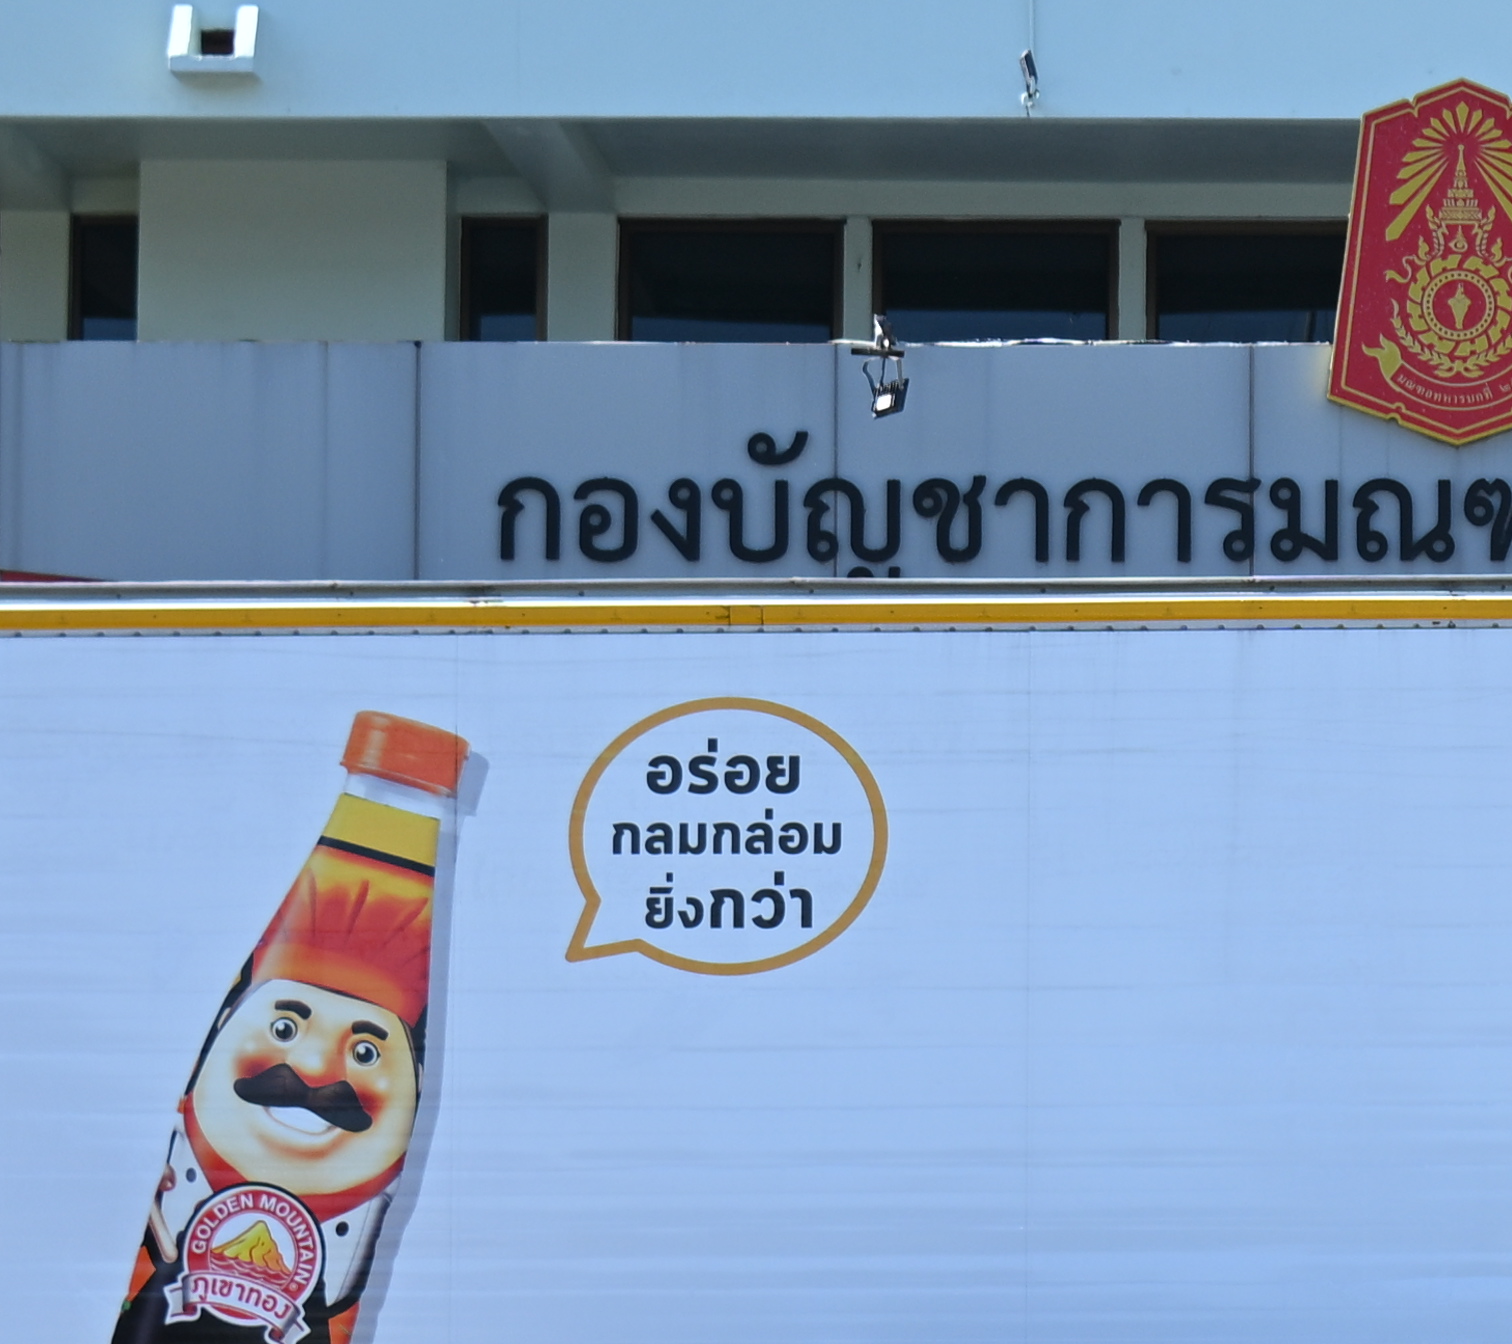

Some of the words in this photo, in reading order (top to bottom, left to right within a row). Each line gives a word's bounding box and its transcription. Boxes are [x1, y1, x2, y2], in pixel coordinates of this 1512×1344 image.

[646, 737, 801, 795] อร่อย
[612, 808, 842, 855] กลมกล่อม
[644, 871, 813, 930] ยิ่งกว่า
[191, 1193, 254, 1254] GOLDEN
[259, 1193, 315, 1285] MOUNTAIN
[191, 1276, 292, 1319] ภูเขาทอง
